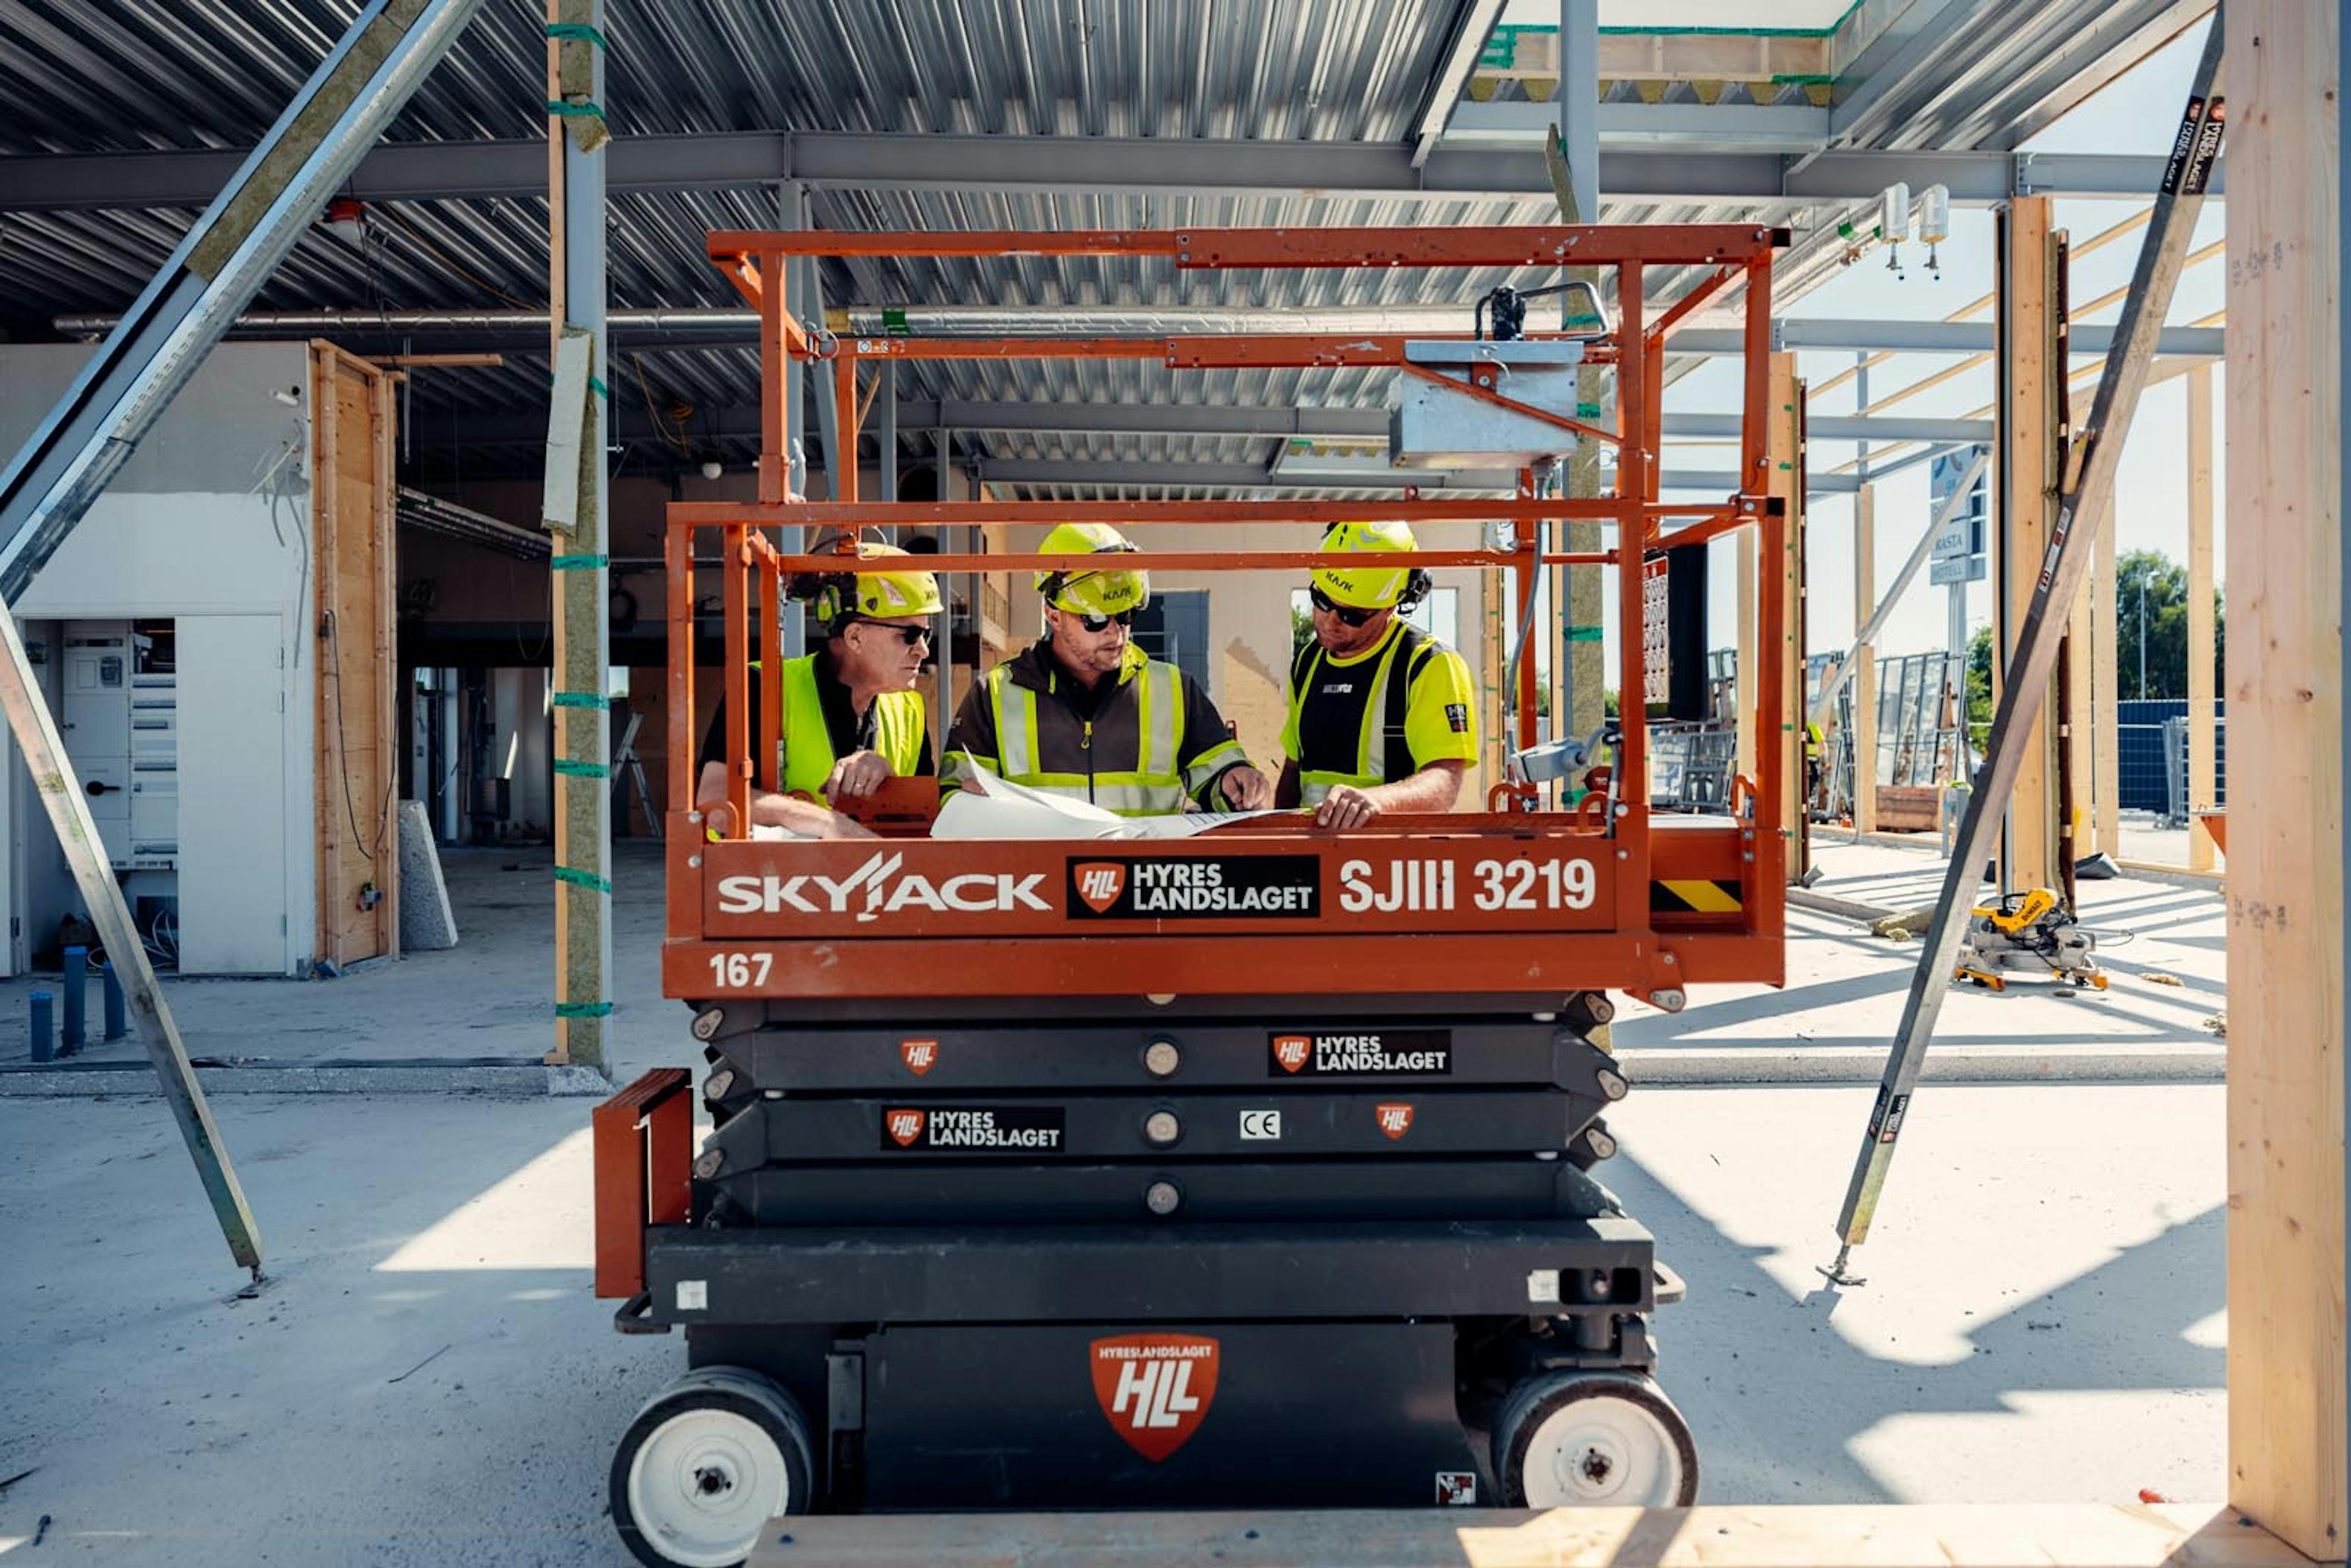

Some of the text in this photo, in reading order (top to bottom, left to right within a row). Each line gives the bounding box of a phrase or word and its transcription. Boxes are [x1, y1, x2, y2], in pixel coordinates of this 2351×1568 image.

[1325, 570, 1354, 592] KASK
[1103, 587, 1131, 601] KASK
[1133, 863, 1223, 887] HYRES
[1339, 859, 1596, 913] SJIII 3219
[717, 851, 1053, 922] SKYJACK
[1133, 887, 1313, 911] LANDSLAGET
[709, 953, 774, 987] 167
[1316, 1035, 1381, 1054] HYRES
[1316, 1051, 1446, 1070] LANDSLAGET
[929, 1111, 994, 1129] HYRES
[1244, 1113, 1277, 1135] CE
[929, 1128, 1060, 1147] LANDSLAGET
[1099, 1345, 1212, 1360] HYRESLANDSLAGET
